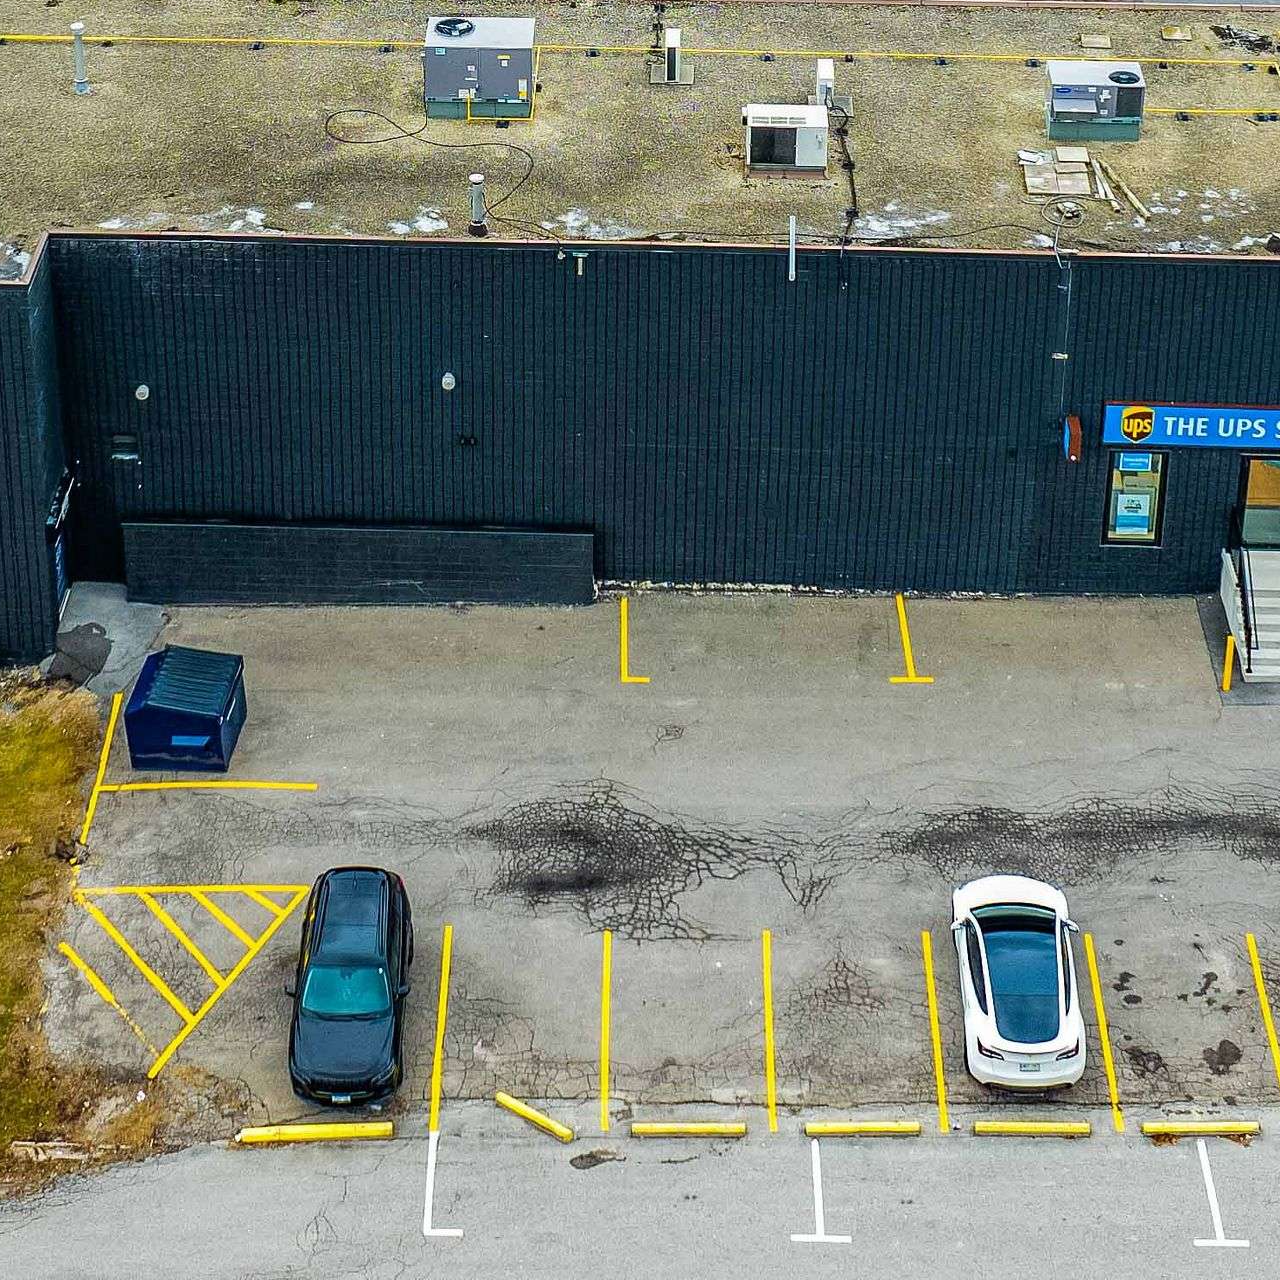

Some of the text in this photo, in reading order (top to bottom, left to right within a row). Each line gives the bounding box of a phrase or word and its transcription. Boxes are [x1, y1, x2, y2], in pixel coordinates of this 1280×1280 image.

[1123, 417, 1153, 439] ups
[1164, 416, 1210, 437] THE
[1219, 417, 1267, 438] UPS
